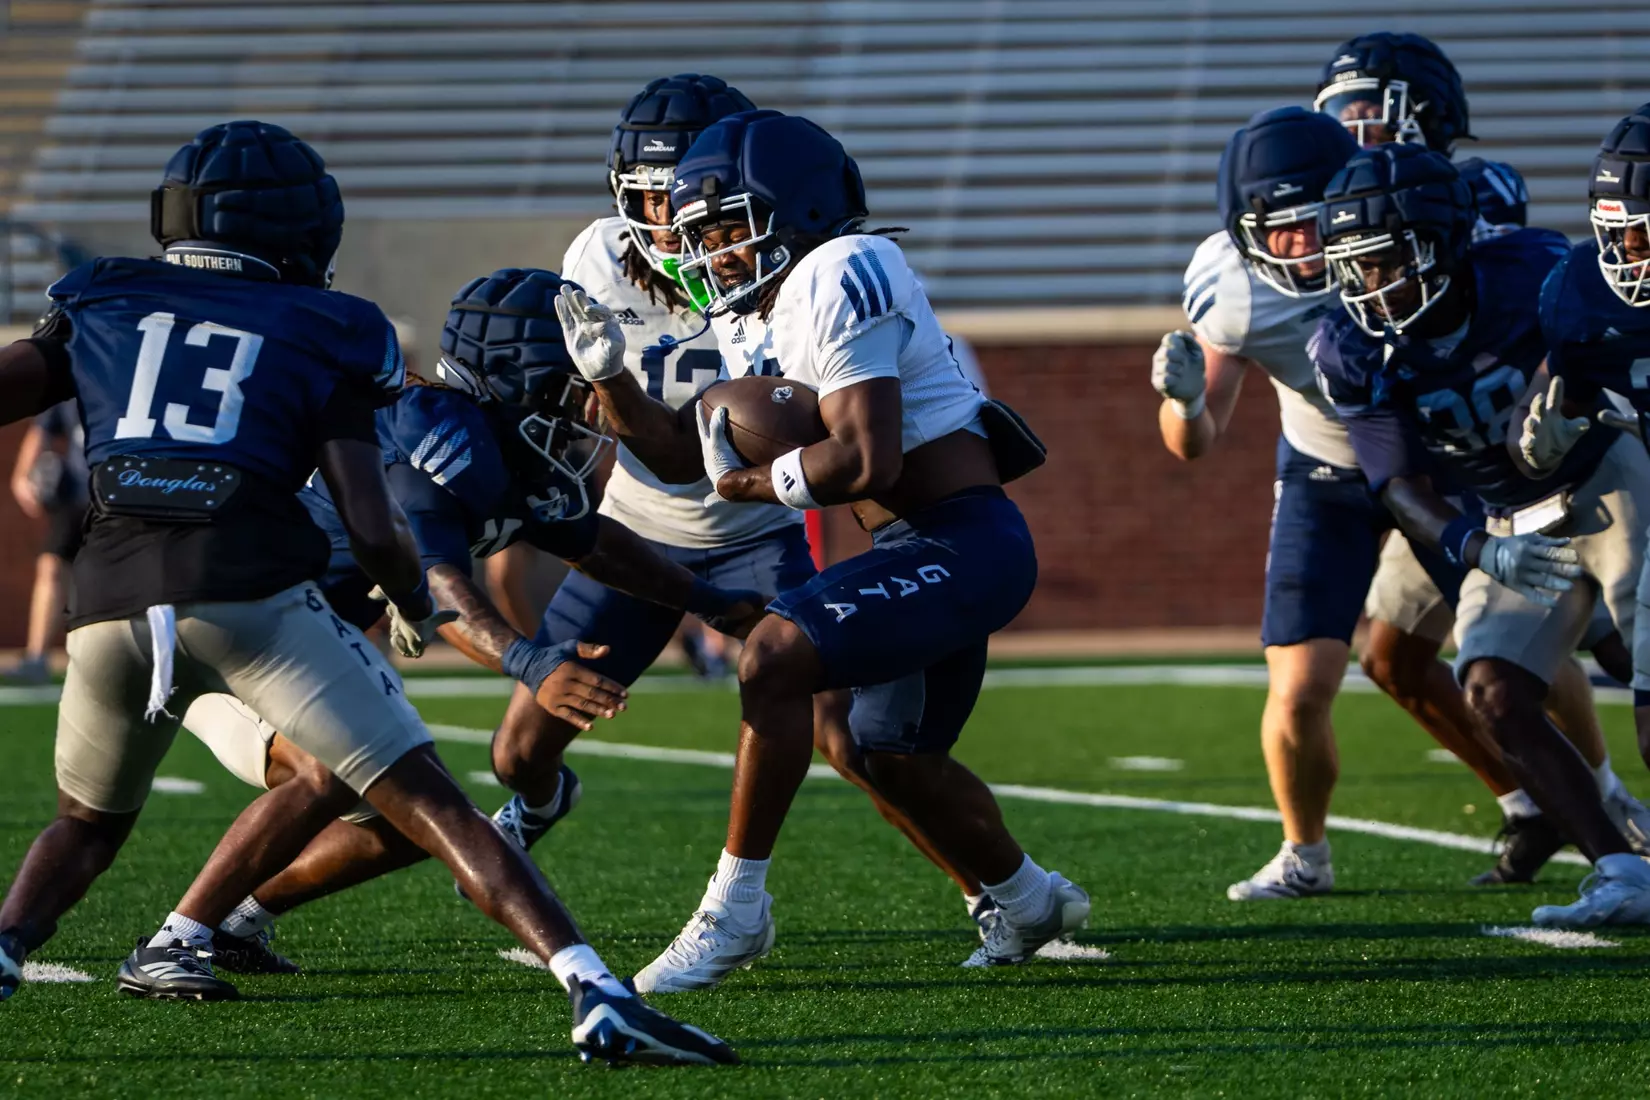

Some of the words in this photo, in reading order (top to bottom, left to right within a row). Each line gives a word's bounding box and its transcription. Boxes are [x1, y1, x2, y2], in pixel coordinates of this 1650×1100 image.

[184, 254, 243, 272] SOUTHERN
[114, 311, 264, 445] 13
[118, 469, 216, 494] Douglas
[824, 564, 951, 624] GATA
[305, 588, 400, 696] GATA
